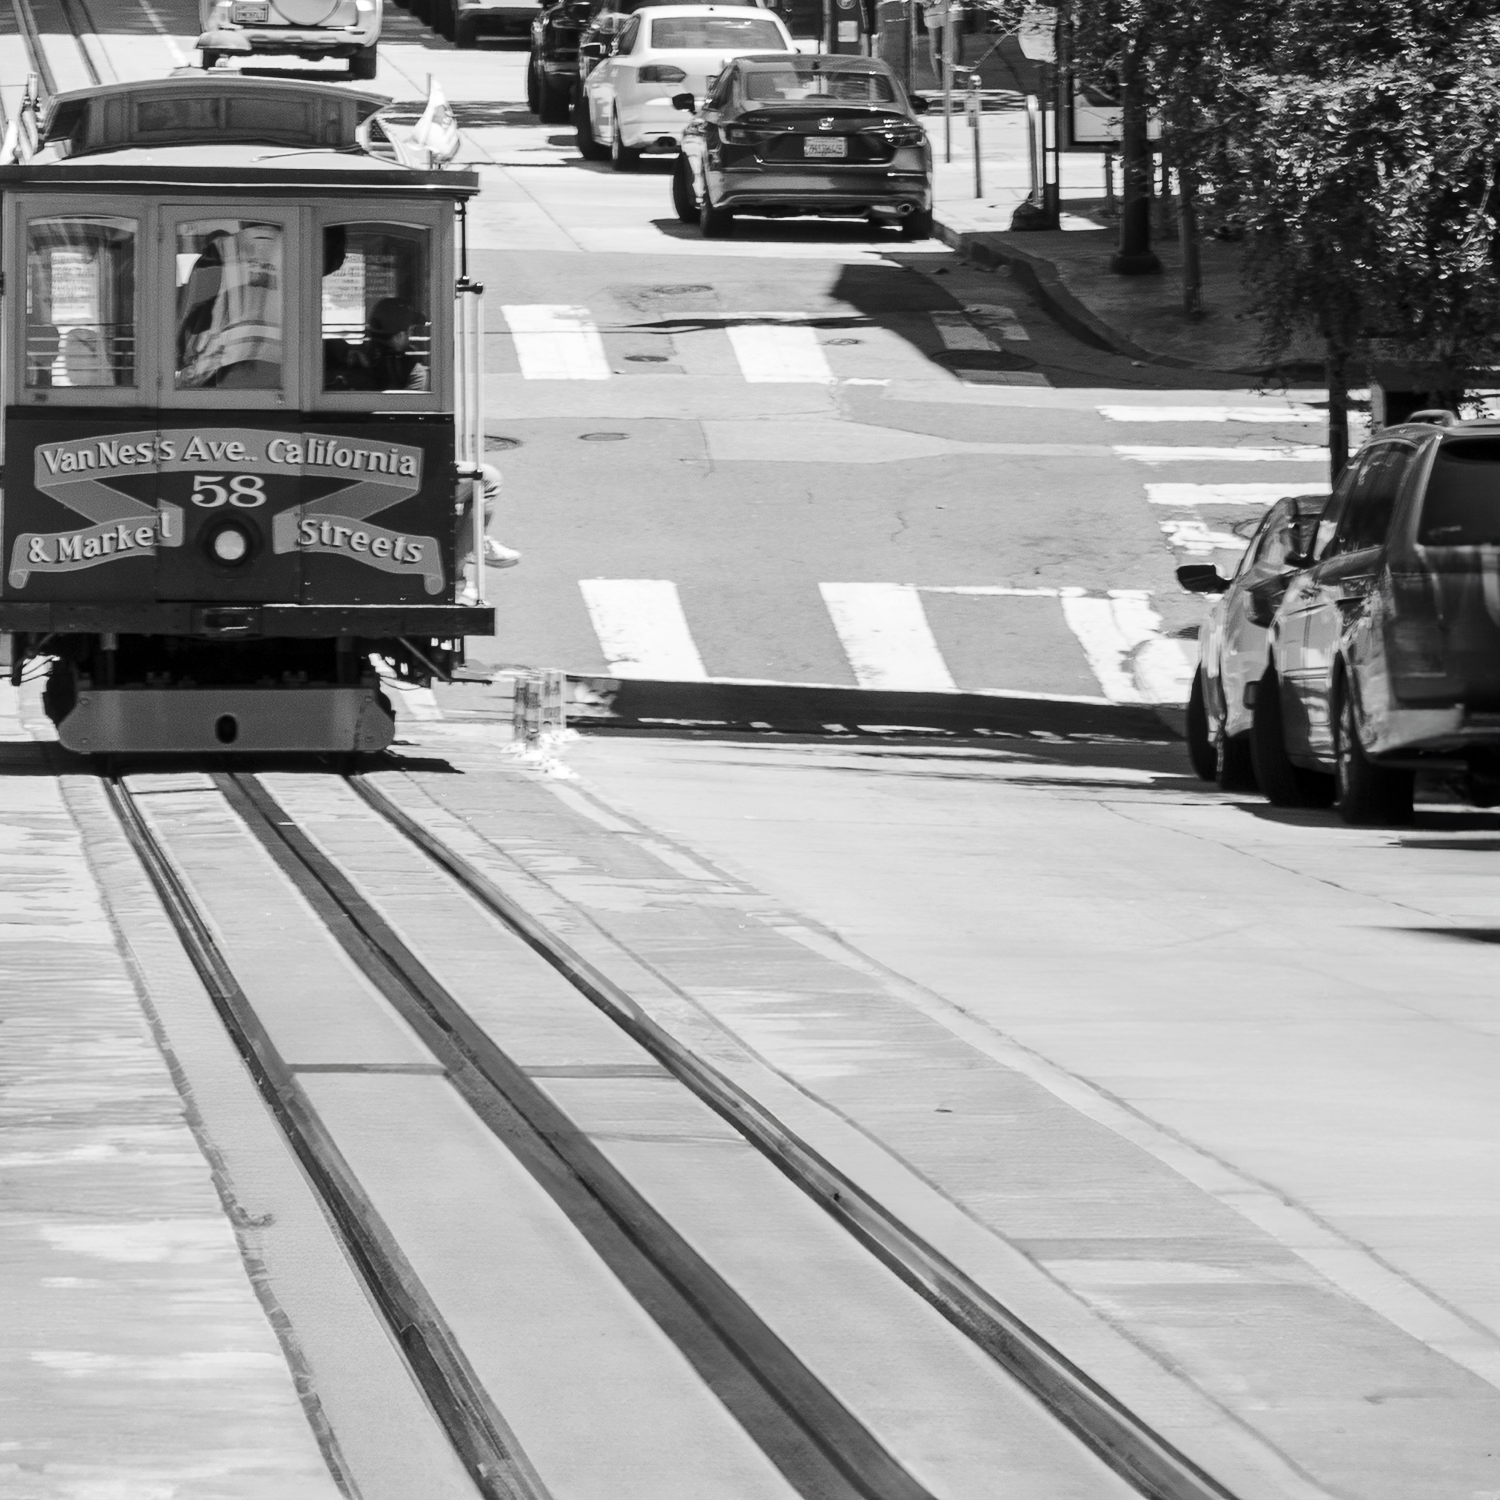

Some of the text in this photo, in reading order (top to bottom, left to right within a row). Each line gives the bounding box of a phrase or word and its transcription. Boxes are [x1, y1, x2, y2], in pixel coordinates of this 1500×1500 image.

[43, 446, 95, 475] Van
[266, 437, 418, 477] California
[190, 474, 267, 508] 58
[28, 510, 173, 563] & Market
[298, 517, 425, 564] Streets
